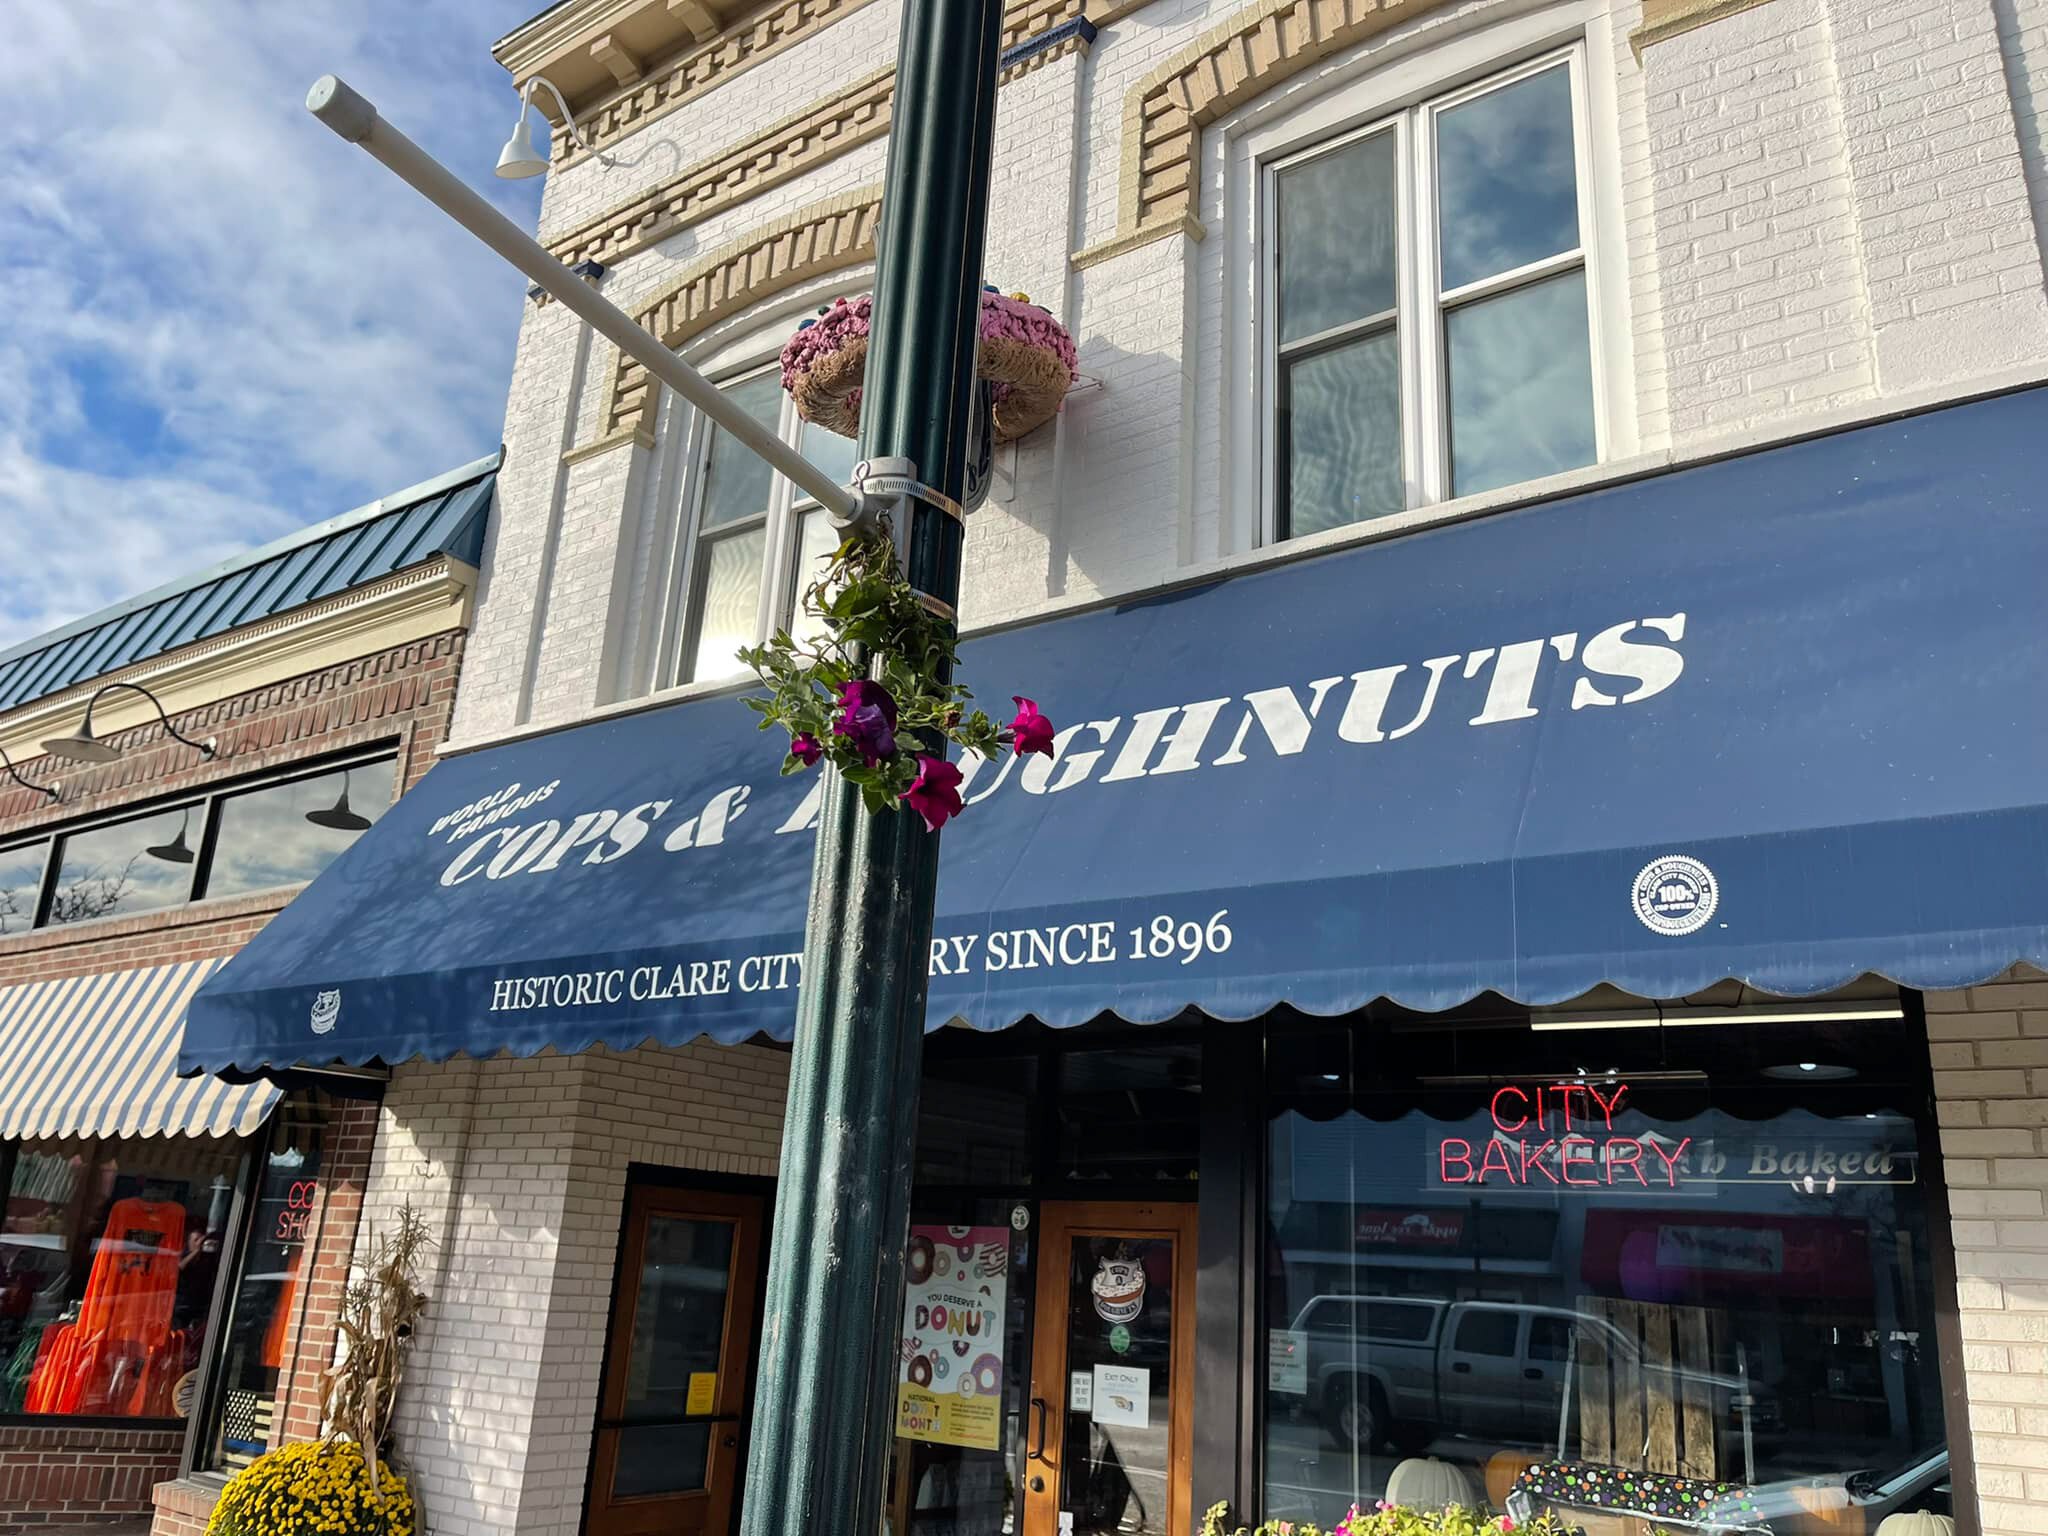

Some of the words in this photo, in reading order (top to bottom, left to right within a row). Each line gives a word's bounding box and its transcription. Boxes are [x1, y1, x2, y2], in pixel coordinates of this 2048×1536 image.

[440, 799, 673, 887] COPS
[664, 784, 752, 853] &
[774, 612, 1686, 834] UGHNUTS
[428, 783, 521, 836] WORLD
[446, 779, 561, 844] FAMOUS
[1659, 885, 1695, 902] 100%
[985, 920, 1117, 973] SINCE
[1129, 909, 1233, 965] 1896
[489, 969, 625, 1011] HISTORIC
[629, 960, 731, 1000] CLARE
[738, 952, 805, 994] CITY
[1491, 1084, 1629, 1132] CITY
[1440, 1137, 1692, 1187] BAKERY
[1747, 1143, 1894, 1175] Baked
[288, 1181, 317, 1208] CO
[915, 1305, 996, 1338] DONUT
[927, 1294, 942, 1302] YOU
[943, 1294, 976, 1308] DESERVE
